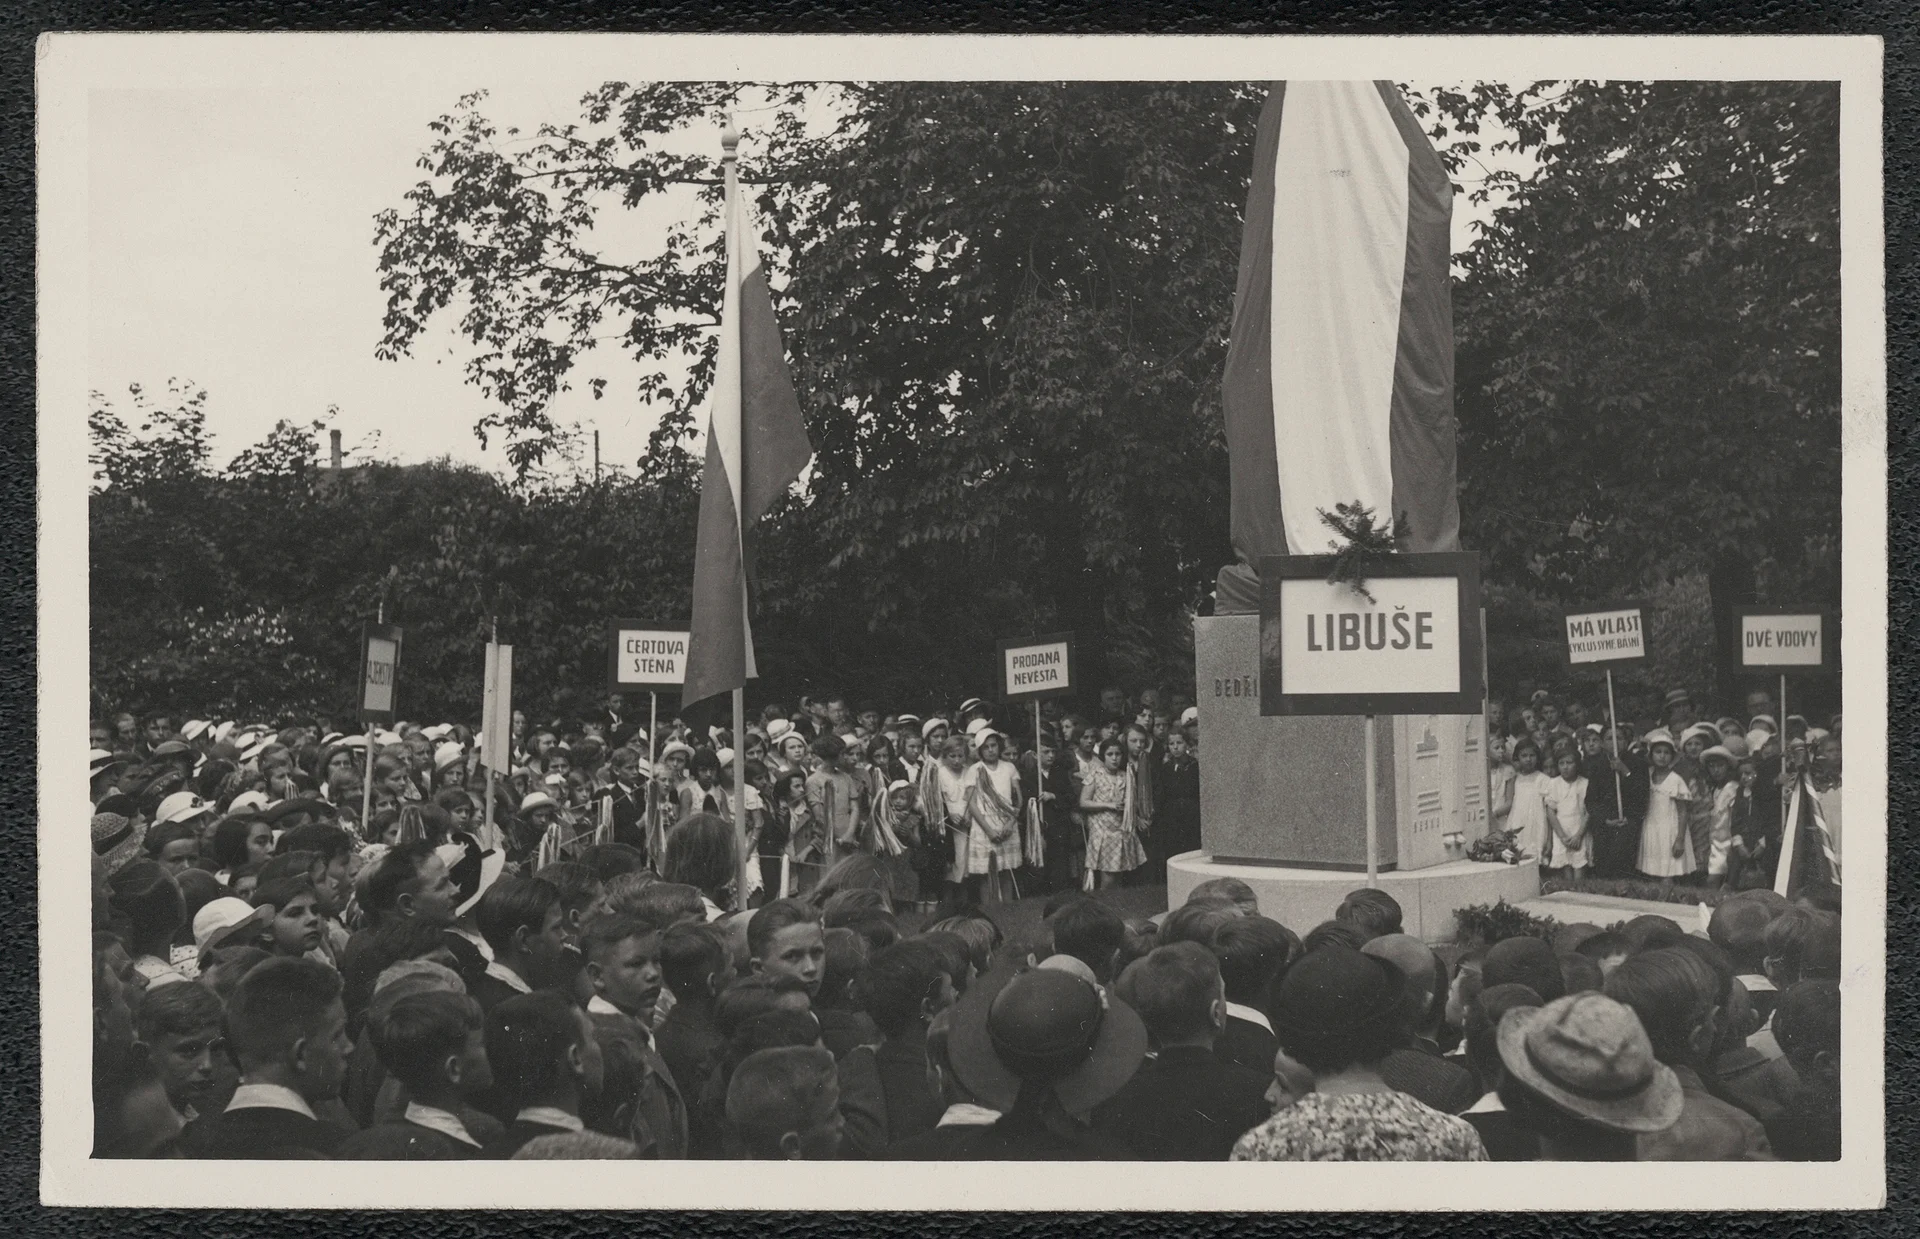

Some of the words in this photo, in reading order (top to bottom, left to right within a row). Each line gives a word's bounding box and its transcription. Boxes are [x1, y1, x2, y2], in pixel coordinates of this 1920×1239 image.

[1307, 605, 1433, 651] LIBUŠE
[1570, 616, 1595, 638] MÁ
[1597, 615, 1639, 636] VLAST
[1775, 630, 1817, 648] VDOVY
[1215, 675, 1257, 697] BEDŘI
